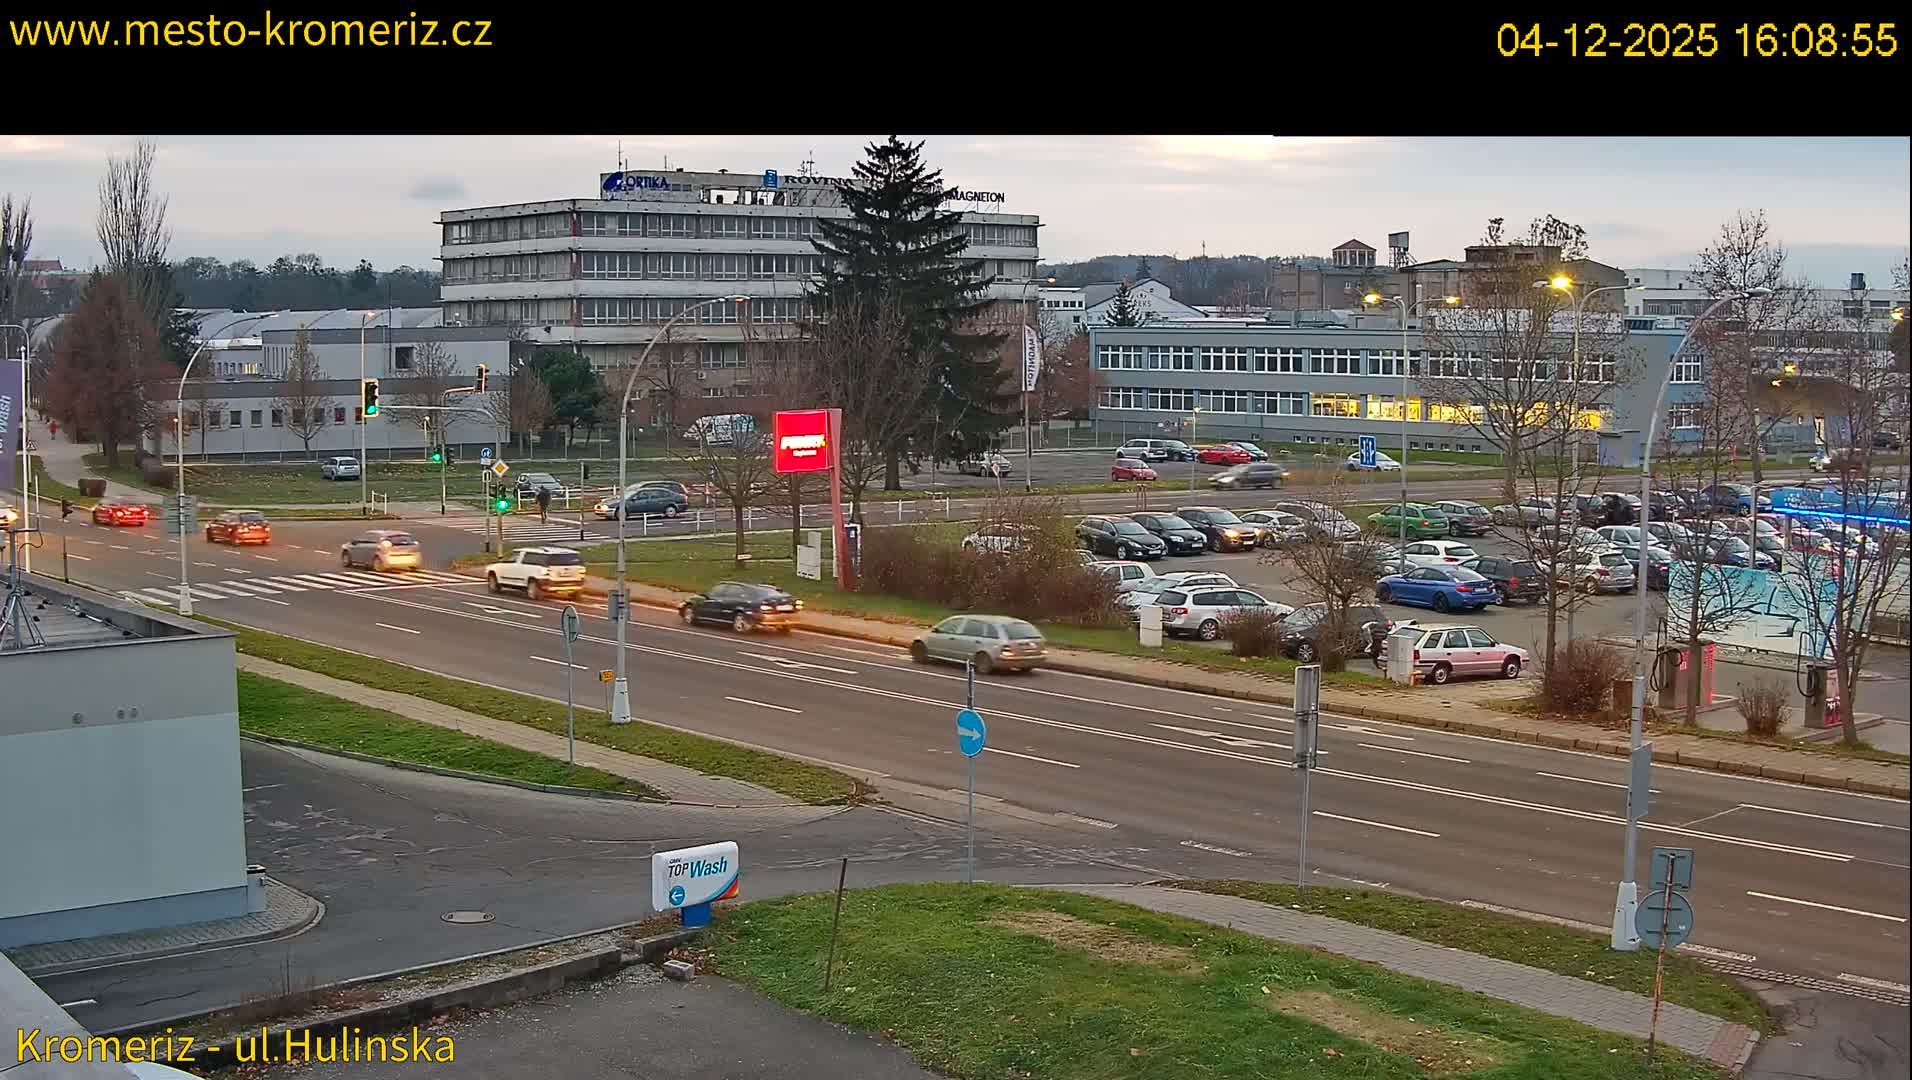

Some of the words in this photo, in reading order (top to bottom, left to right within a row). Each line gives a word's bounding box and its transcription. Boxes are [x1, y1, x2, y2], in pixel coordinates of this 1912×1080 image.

[951, 191, 1004, 203] MAGNETON
[668, 863, 688, 878] TOP
[690, 856, 727, 878] Wash
